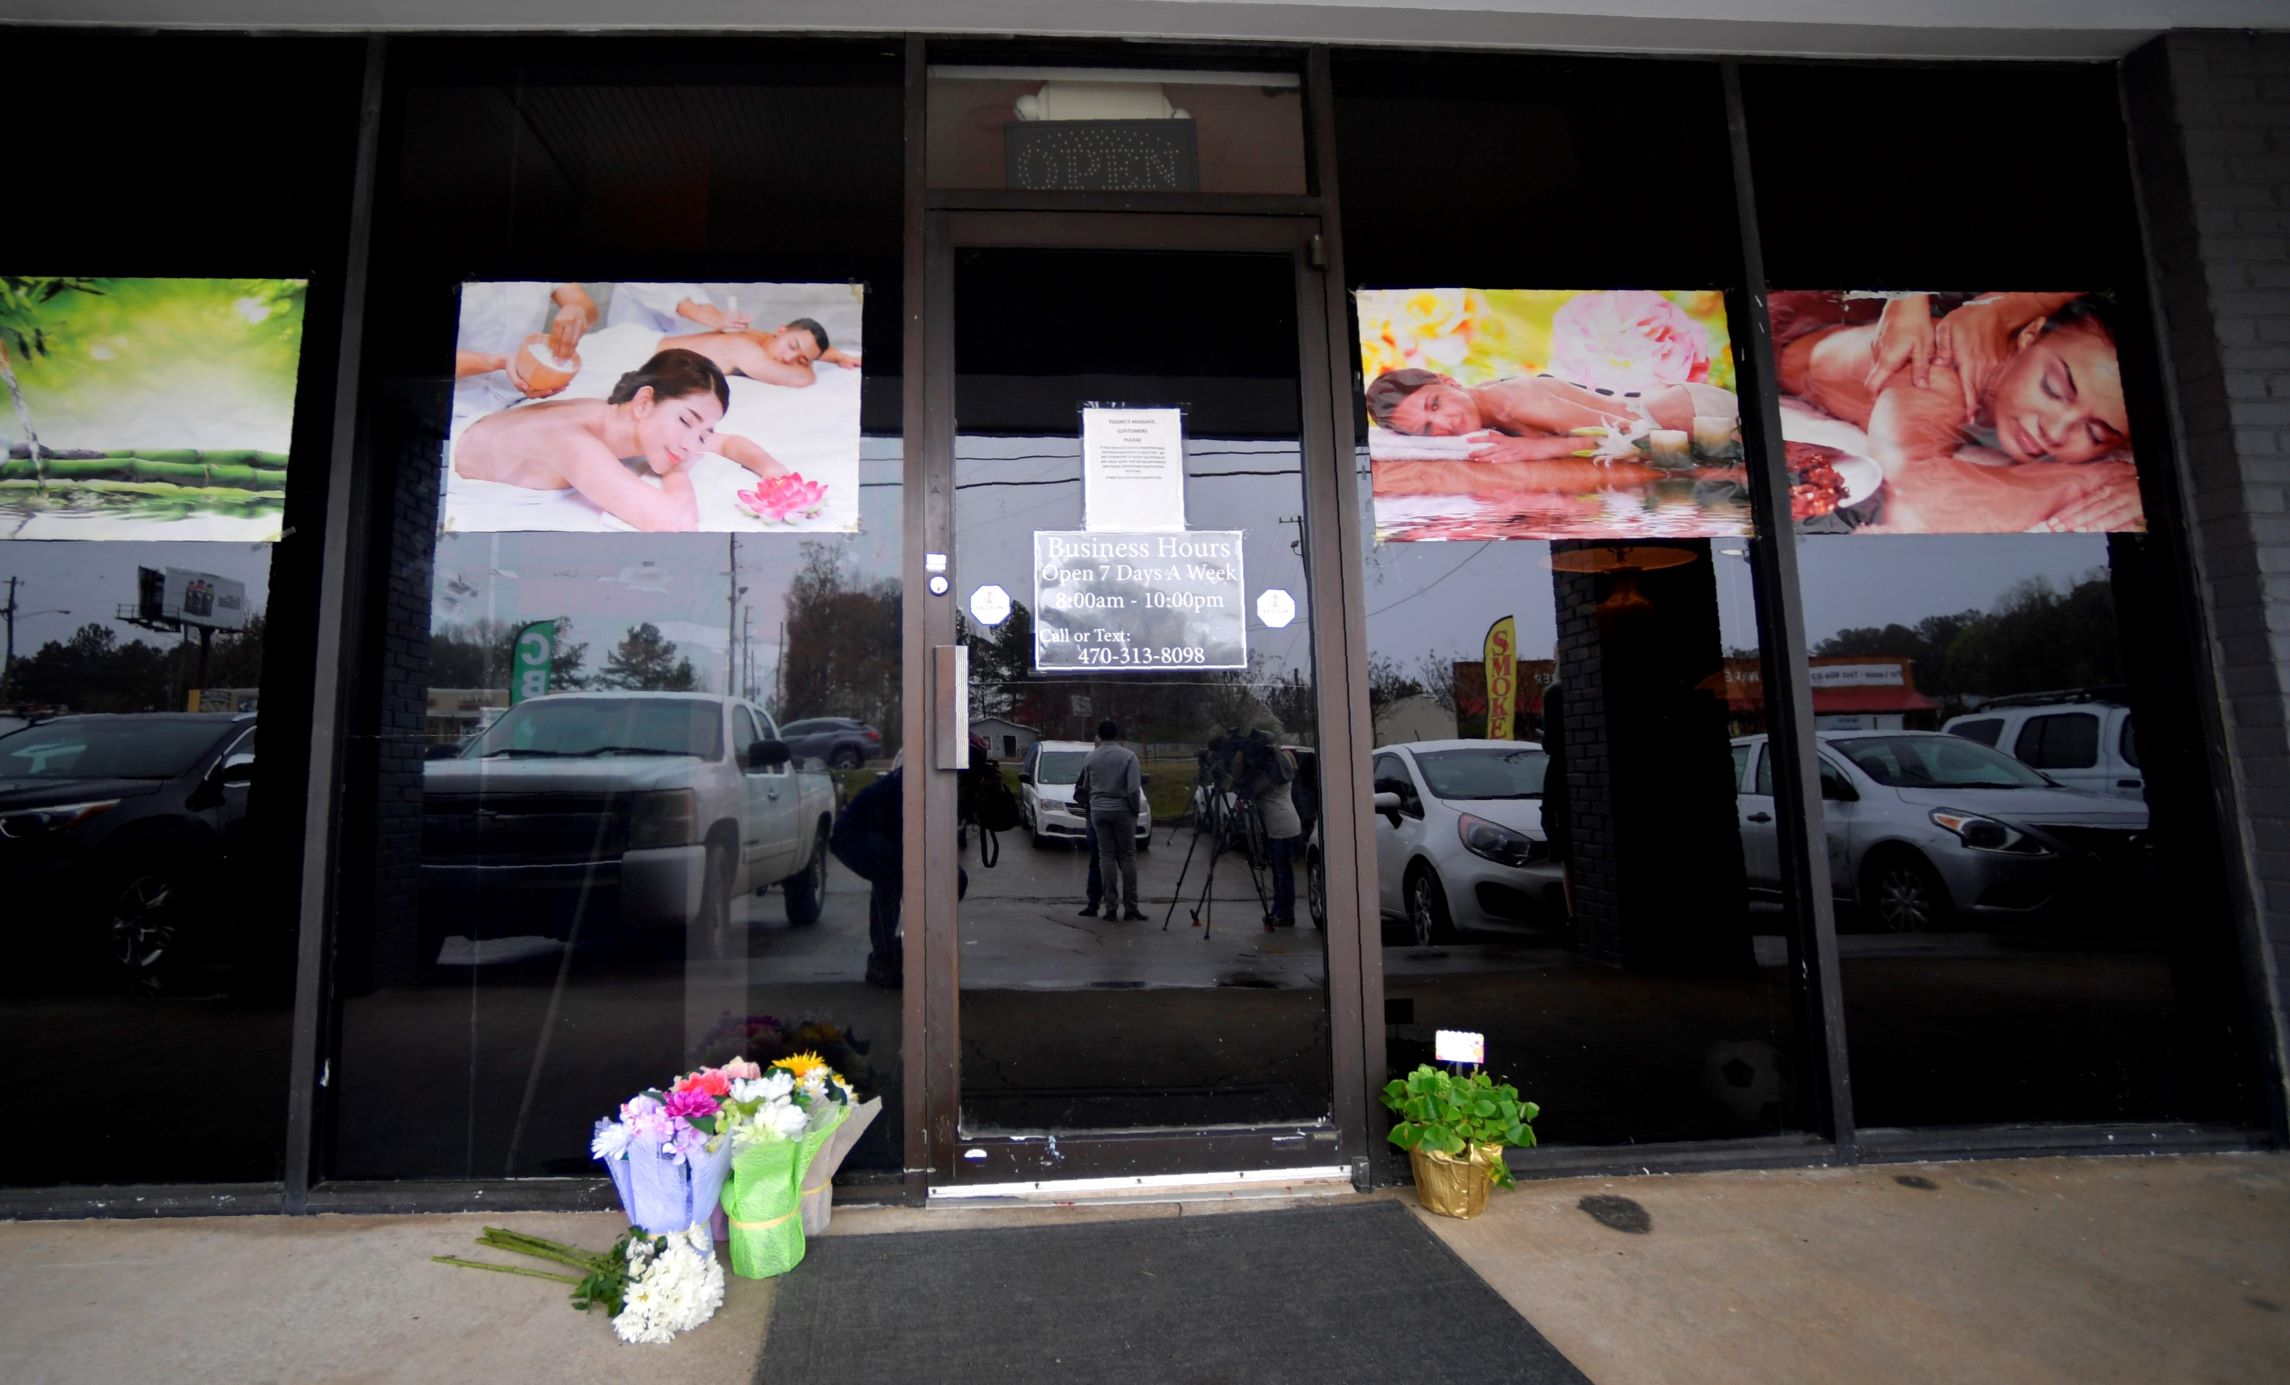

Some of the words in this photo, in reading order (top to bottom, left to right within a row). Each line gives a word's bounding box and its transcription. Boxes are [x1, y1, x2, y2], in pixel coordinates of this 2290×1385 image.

[1018, 149, 1179, 190] OPEN
[1048, 537, 1149, 558] Business
[1157, 537, 1231, 558] Hours
[1042, 564, 1094, 587] Open
[1099, 565, 1110, 581] 7
[1117, 564, 1162, 587] Days
[1166, 564, 1181, 581] A
[1186, 563, 1236, 581] Week
[1055, 592, 1125, 609] 8:00am
[1145, 591, 1224, 613] 10:00pm
[1040, 628, 1069, 643] Call
[1074, 632, 1090, 643] or
[1093, 628, 1131, 643] Text:
[1078, 647, 1205, 665] 470-313-8098
[1491, 630, 1512, 740] SMOKE
